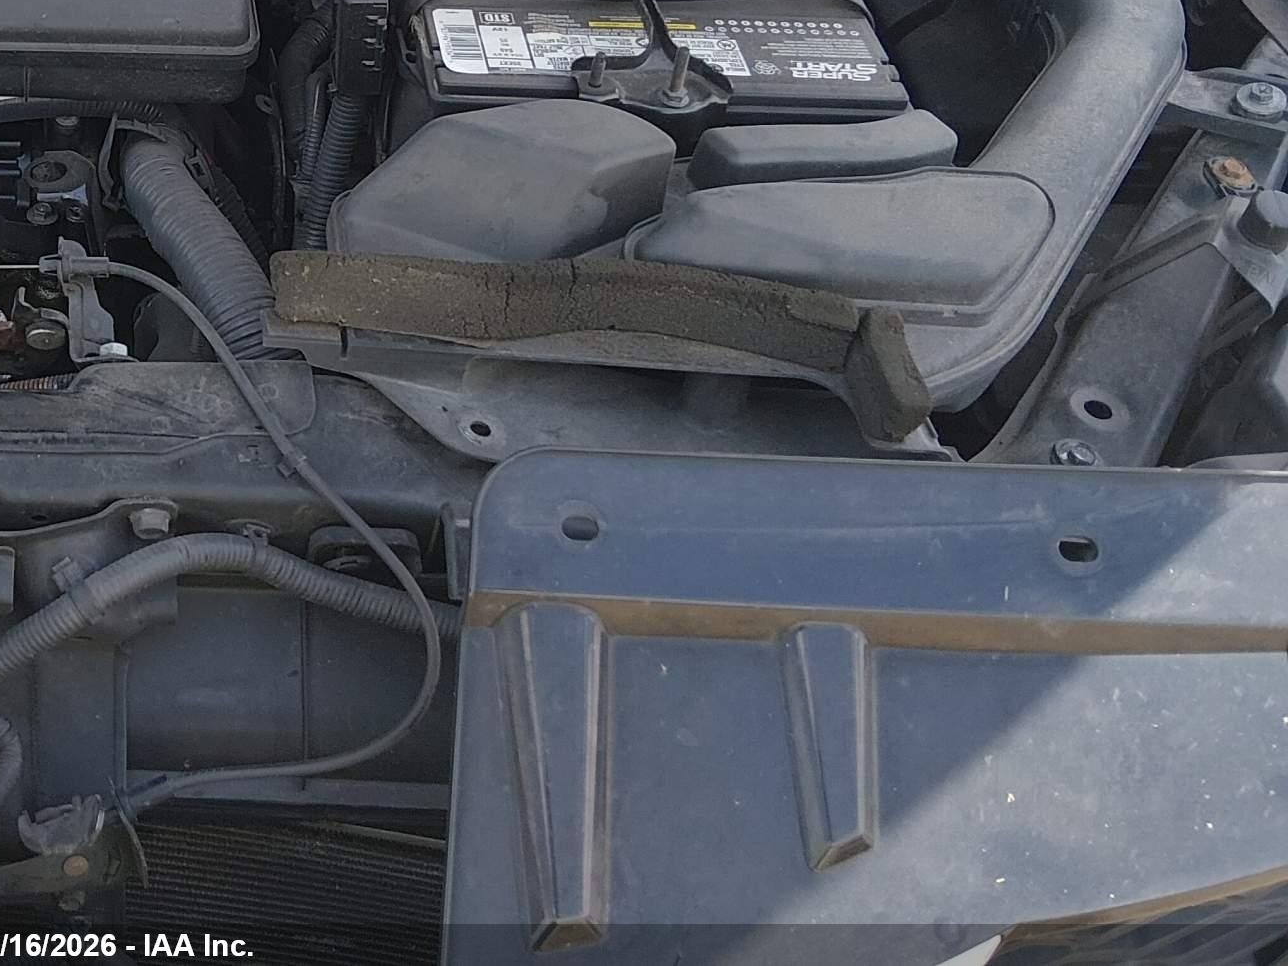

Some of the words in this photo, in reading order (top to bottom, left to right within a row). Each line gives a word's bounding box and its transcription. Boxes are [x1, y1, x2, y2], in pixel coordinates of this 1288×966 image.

[484, 13, 511, 23] STD
[790, 62, 878, 75] START
[792, 70, 872, 82] SUPER
